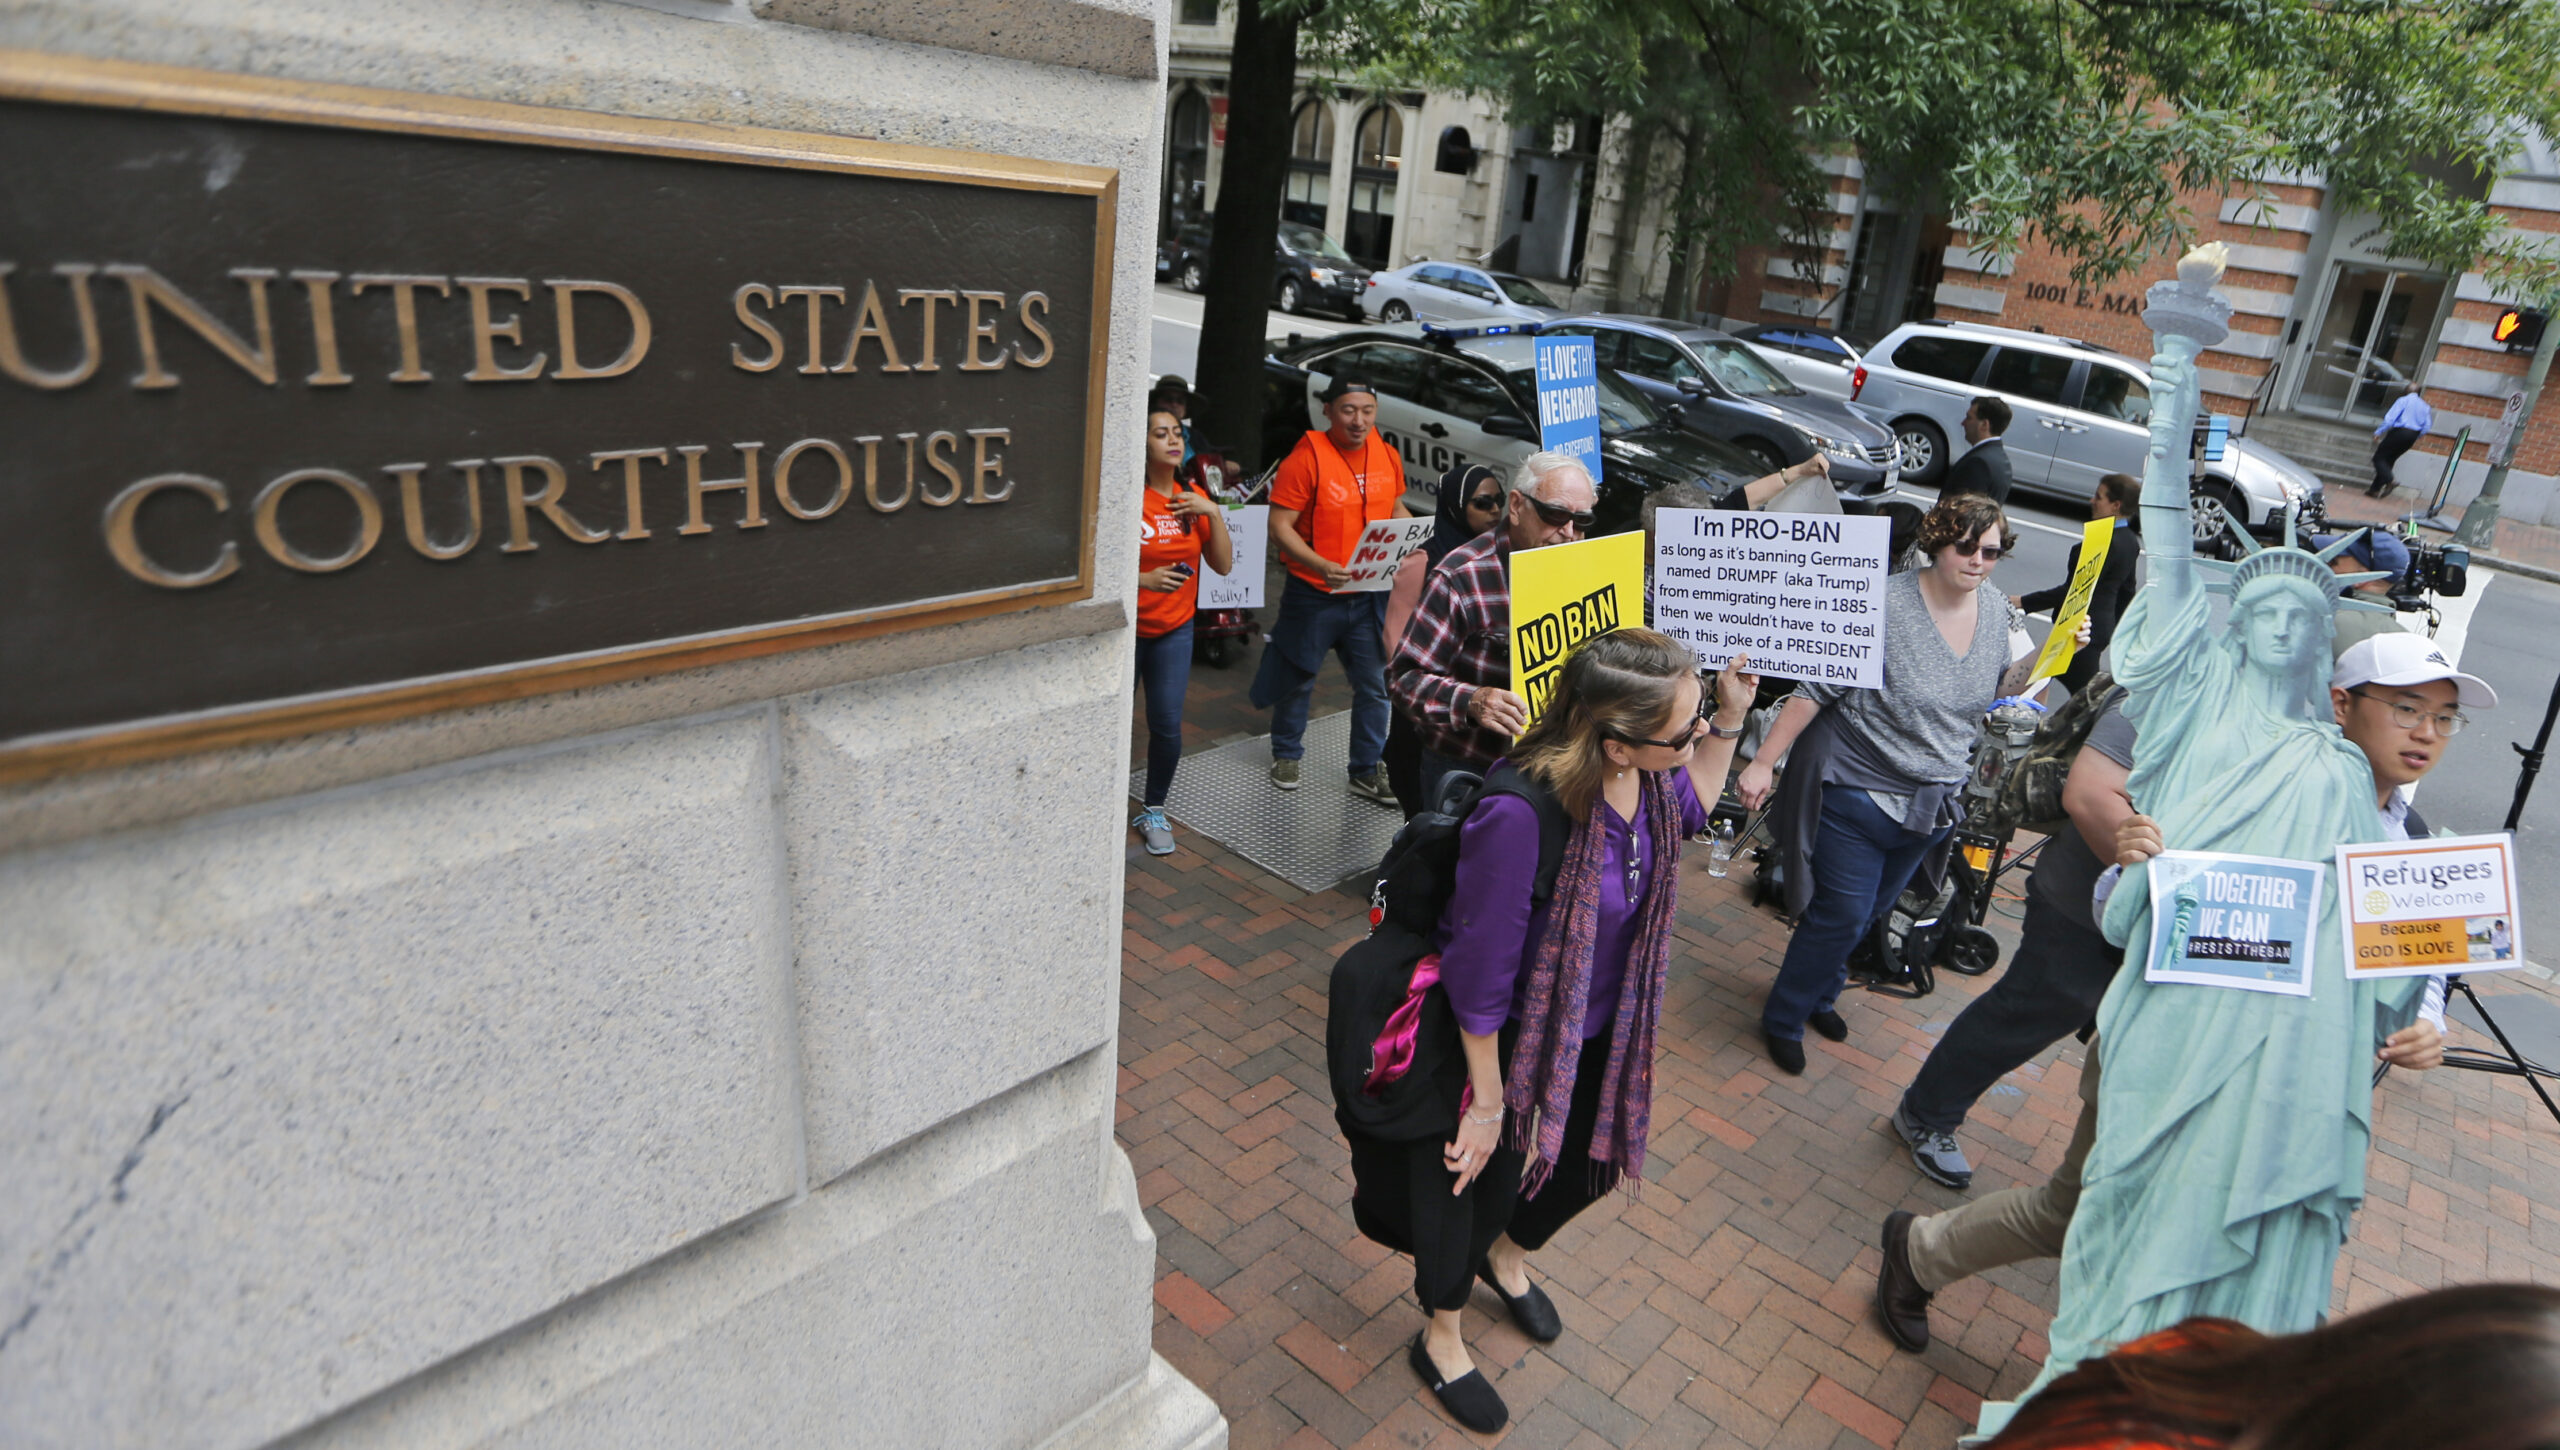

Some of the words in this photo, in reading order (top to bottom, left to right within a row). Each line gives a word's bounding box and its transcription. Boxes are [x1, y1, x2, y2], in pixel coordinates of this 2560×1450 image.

[2025, 282, 2067, 304] 1001
[0, 263, 652, 390] UNITED
[732, 279, 1055, 374] STATES
[1541, 385, 1598, 427] NEIGHBOR
[1383, 431, 1467, 473] OLICE
[104, 427, 1016, 589] COURTHOUSE
[1364, 526, 1397, 544] No
[1694, 515, 1724, 537] I'm
[1731, 517, 1841, 543] PRO-BAN
[1353, 544, 1388, 565] No
[1661, 545, 1674, 556] as
[1677, 543, 1706, 561] long
[1709, 547, 1723, 559] as
[1727, 546, 1745, 560] it's
[1749, 547, 1806, 568] banning
[1811, 551, 1879, 569] Germans
[1666, 566, 1711, 579] named
[1717, 567, 1778, 584] DRUMPF
[1785, 571, 1813, 587] (aka
[1817, 573, 1870, 594] Trump)
[1210, 586, 1250, 604] Bully!
[1659, 583, 1689, 598] from
[1692, 588, 1776, 610] emmigrating
[1780, 593, 1811, 609] here
[1815, 596, 1827, 610] in
[1831, 598, 1867, 614] 1885
[1517, 612, 1563, 673] NO
[1561, 582, 1620, 652] BAN
[1660, 605, 1688, 619] then
[1694, 610, 1713, 622] we
[1719, 612, 1777, 628] wouldn't
[1781, 615, 1814, 631] have
[1821, 620, 1836, 634] to
[1843, 622, 1875, 637] deal
[1662, 626, 1690, 640] with
[1695, 629, 1718, 643] this
[1723, 631, 1753, 647] joke
[1756, 635, 1771, 649] of
[1774, 640, 1783, 650] a
[1787, 638, 1871, 660] PRESIDENT
[1710, 653, 1821, 677] uncnstitutional
[1826, 664, 1858, 681] BAN
[2362, 860, 2493, 890] Refugees
[2203, 870, 2297, 910] TOGETHER
[2390, 891, 2486, 908] Welcome
[2199, 907, 2226, 938] WE
[2228, 909, 2270, 944] CAN
[2380, 922, 2441, 936] Because
[2188, 941, 2291, 960] #RESISTTHEBAN
[2358, 944, 2394, 959] GOD
[2398, 943, 2413, 956] IS
[2415, 940, 2455, 955] LOVE
